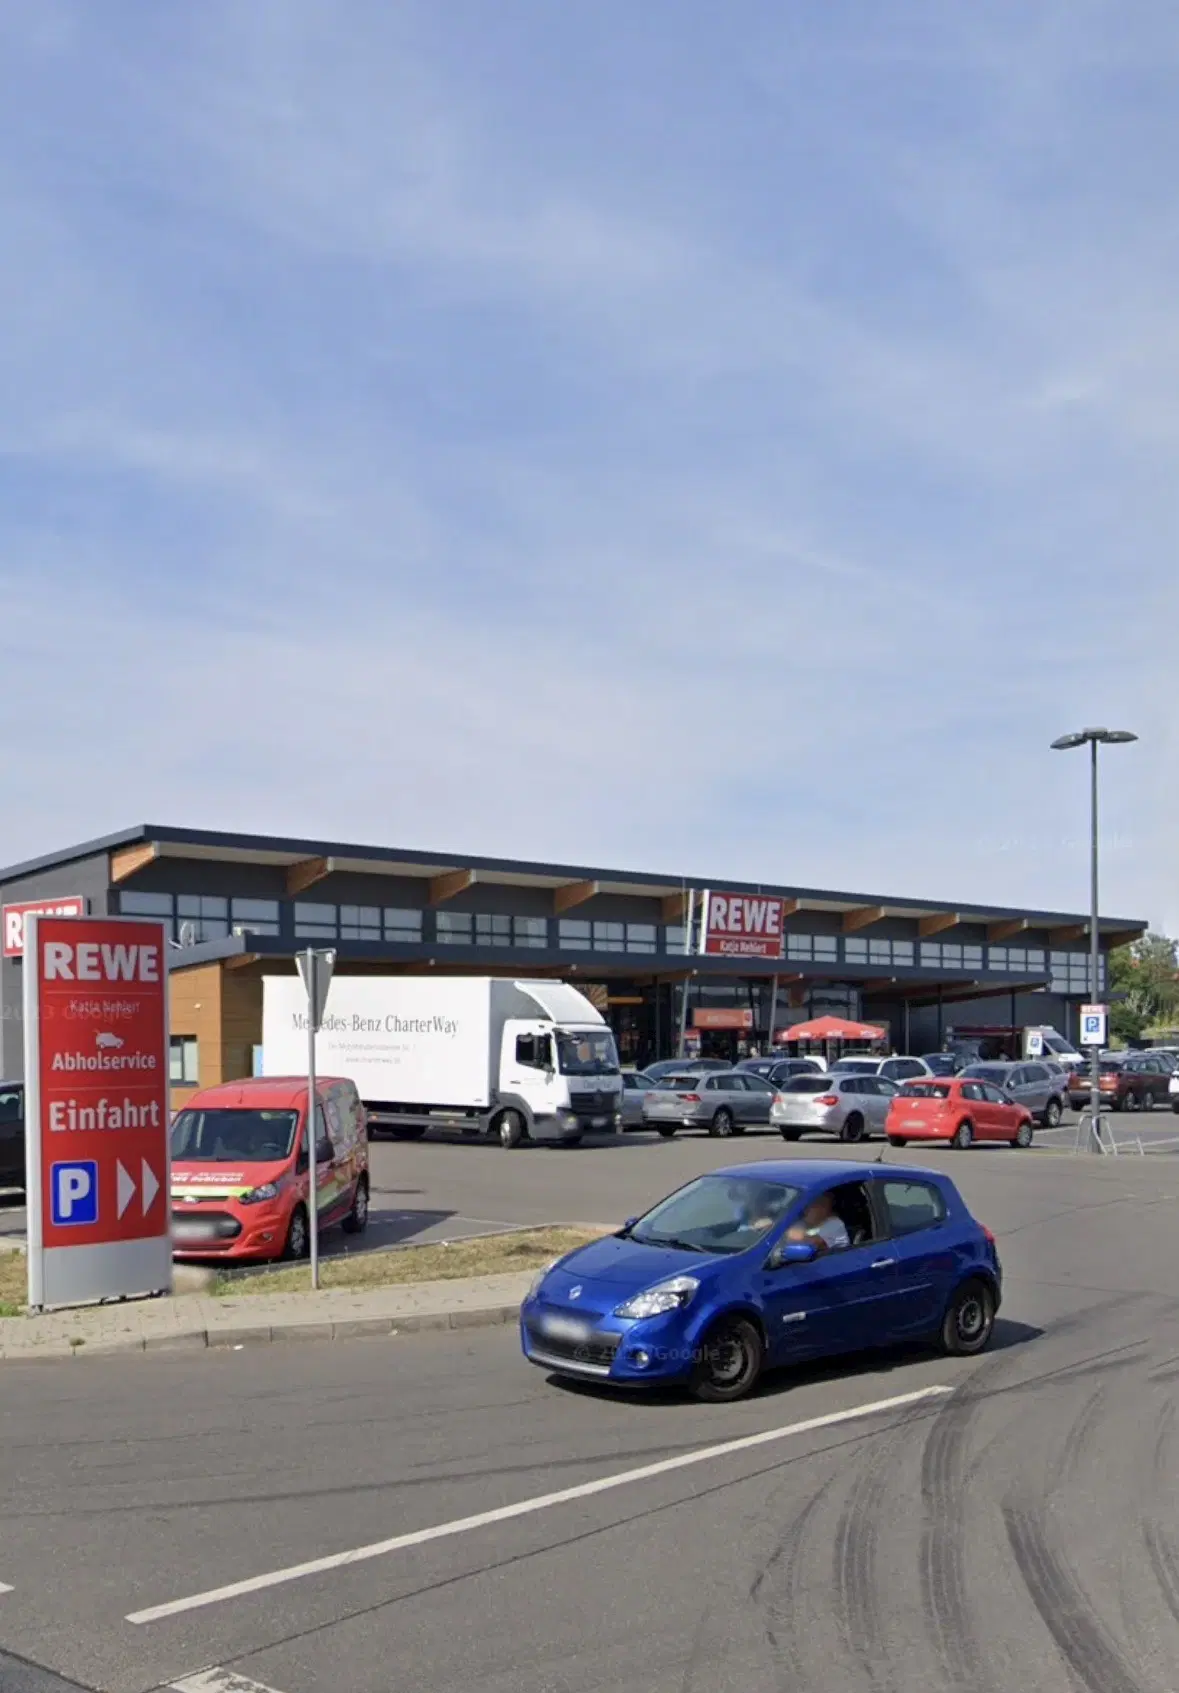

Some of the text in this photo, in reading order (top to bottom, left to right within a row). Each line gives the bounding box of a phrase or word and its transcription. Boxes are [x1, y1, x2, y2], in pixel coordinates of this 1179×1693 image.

[710, 896, 781, 934] REWE
[43, 942, 159, 981] REWE
[292, 1013, 459, 1038] Meedes-Benz CharterWay
[51, 1051, 157, 1072] Abholservice
[49, 1098, 160, 1132] Einfahrt
[58, 1168, 91, 1218] P
